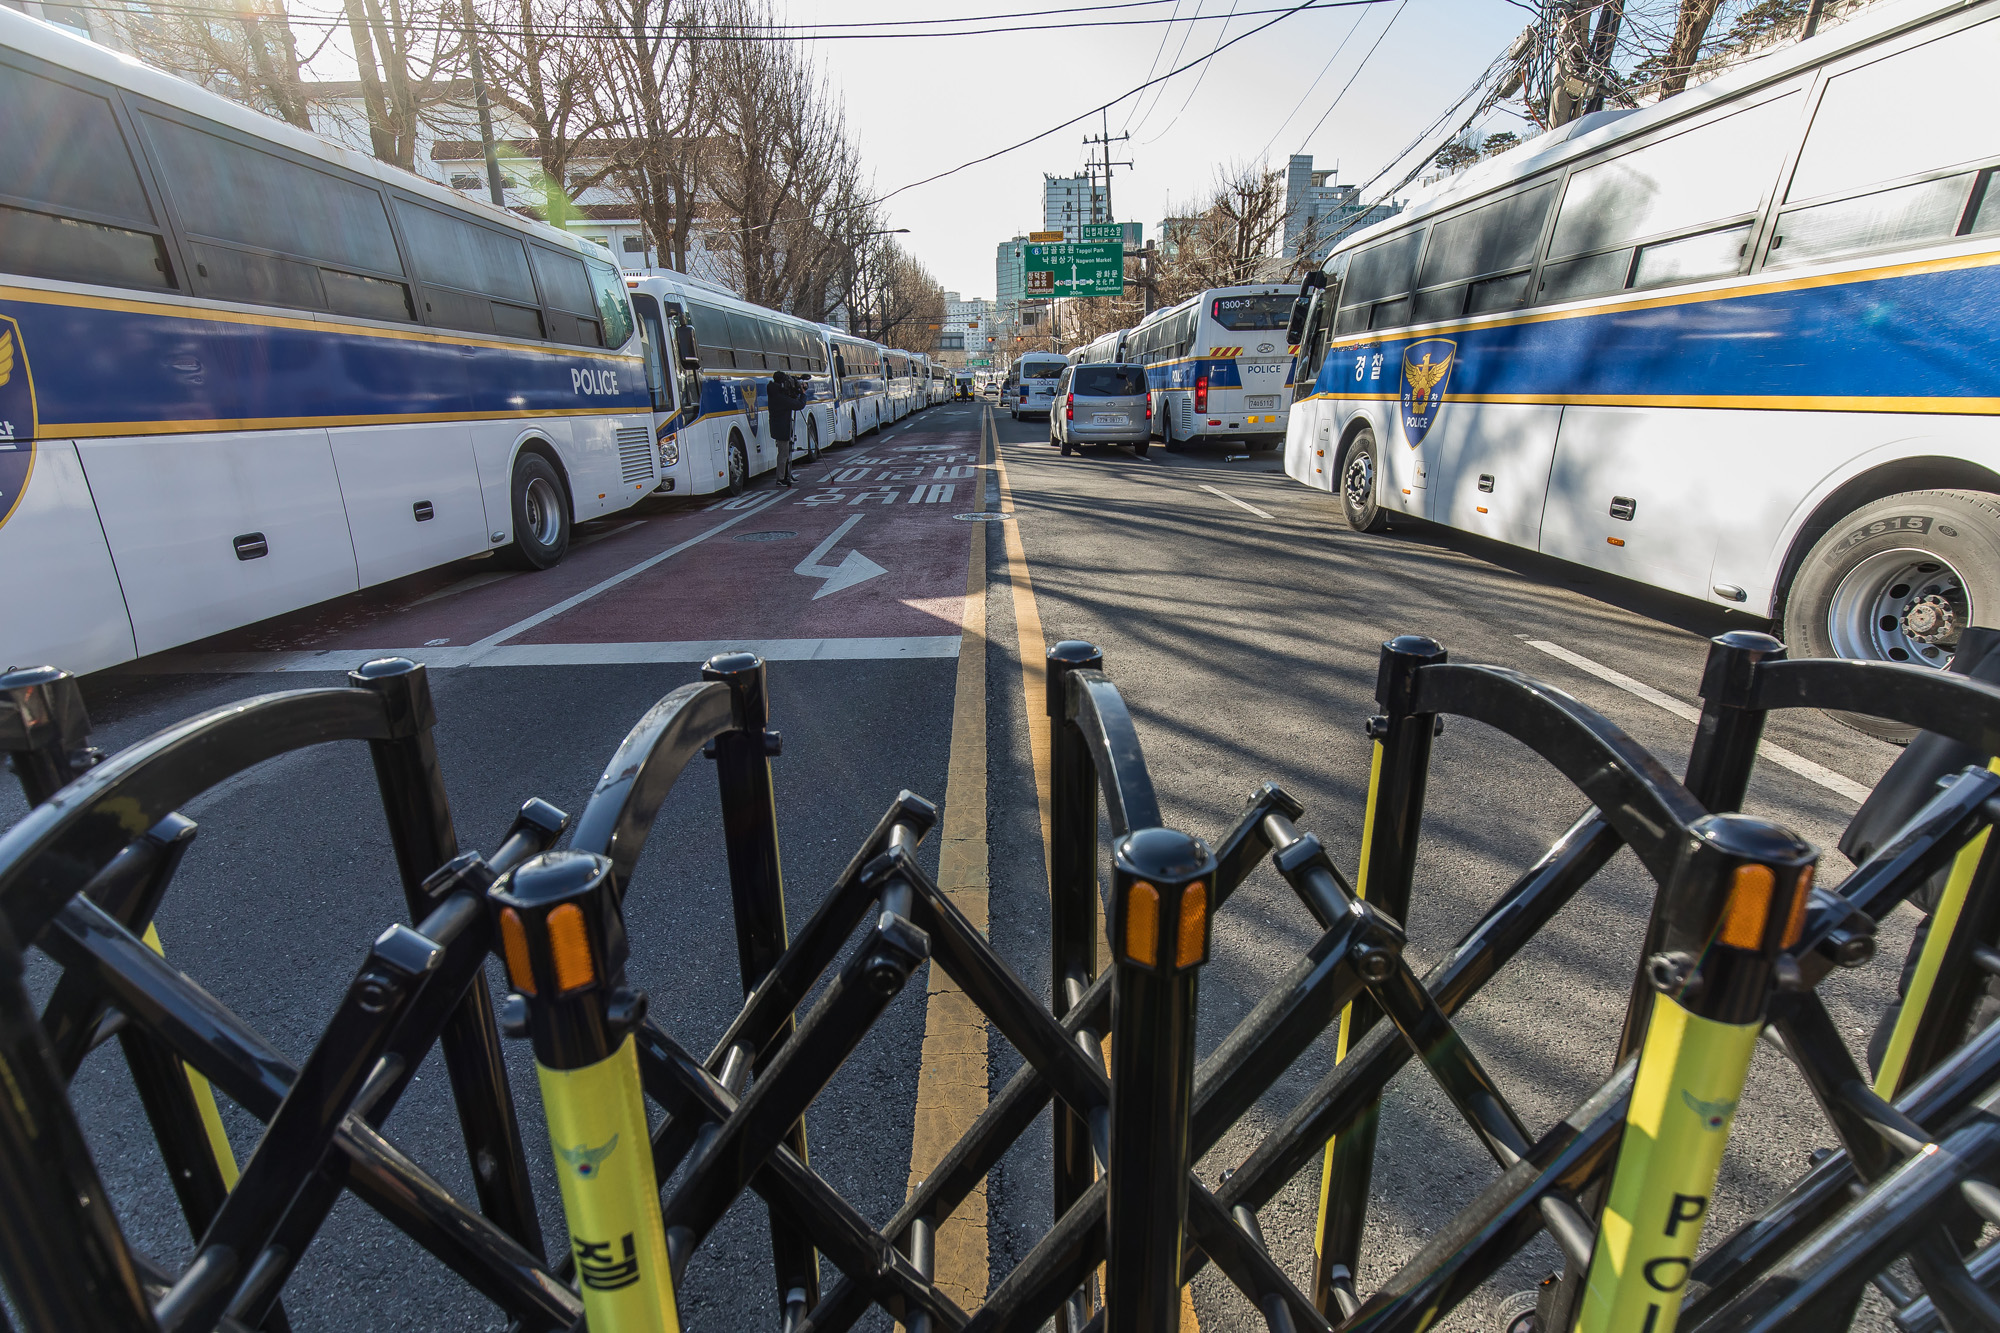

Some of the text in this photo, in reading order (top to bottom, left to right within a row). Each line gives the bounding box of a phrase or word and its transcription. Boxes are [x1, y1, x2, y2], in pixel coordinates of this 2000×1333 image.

[1085, 226, 1121, 237] 헌법재판소앞
[1042, 245, 1075, 255] 탑골공원
[1042, 255, 1074, 265] 낙원상가
[1096, 270, 1118, 278] 광화문
[1221, 299, 1251, 309] 1300-3
[1247, 365, 1281, 374] POLICE
[1355, 353, 1384, 382] 경찰
[571, 368, 620, 396] POLICE
[1406, 416, 1428, 429] POLICE
[817, 465, 976, 483] 어린이
[793, 484, 956, 507] 비보호
[573, 1232, 641, 1291] 질
